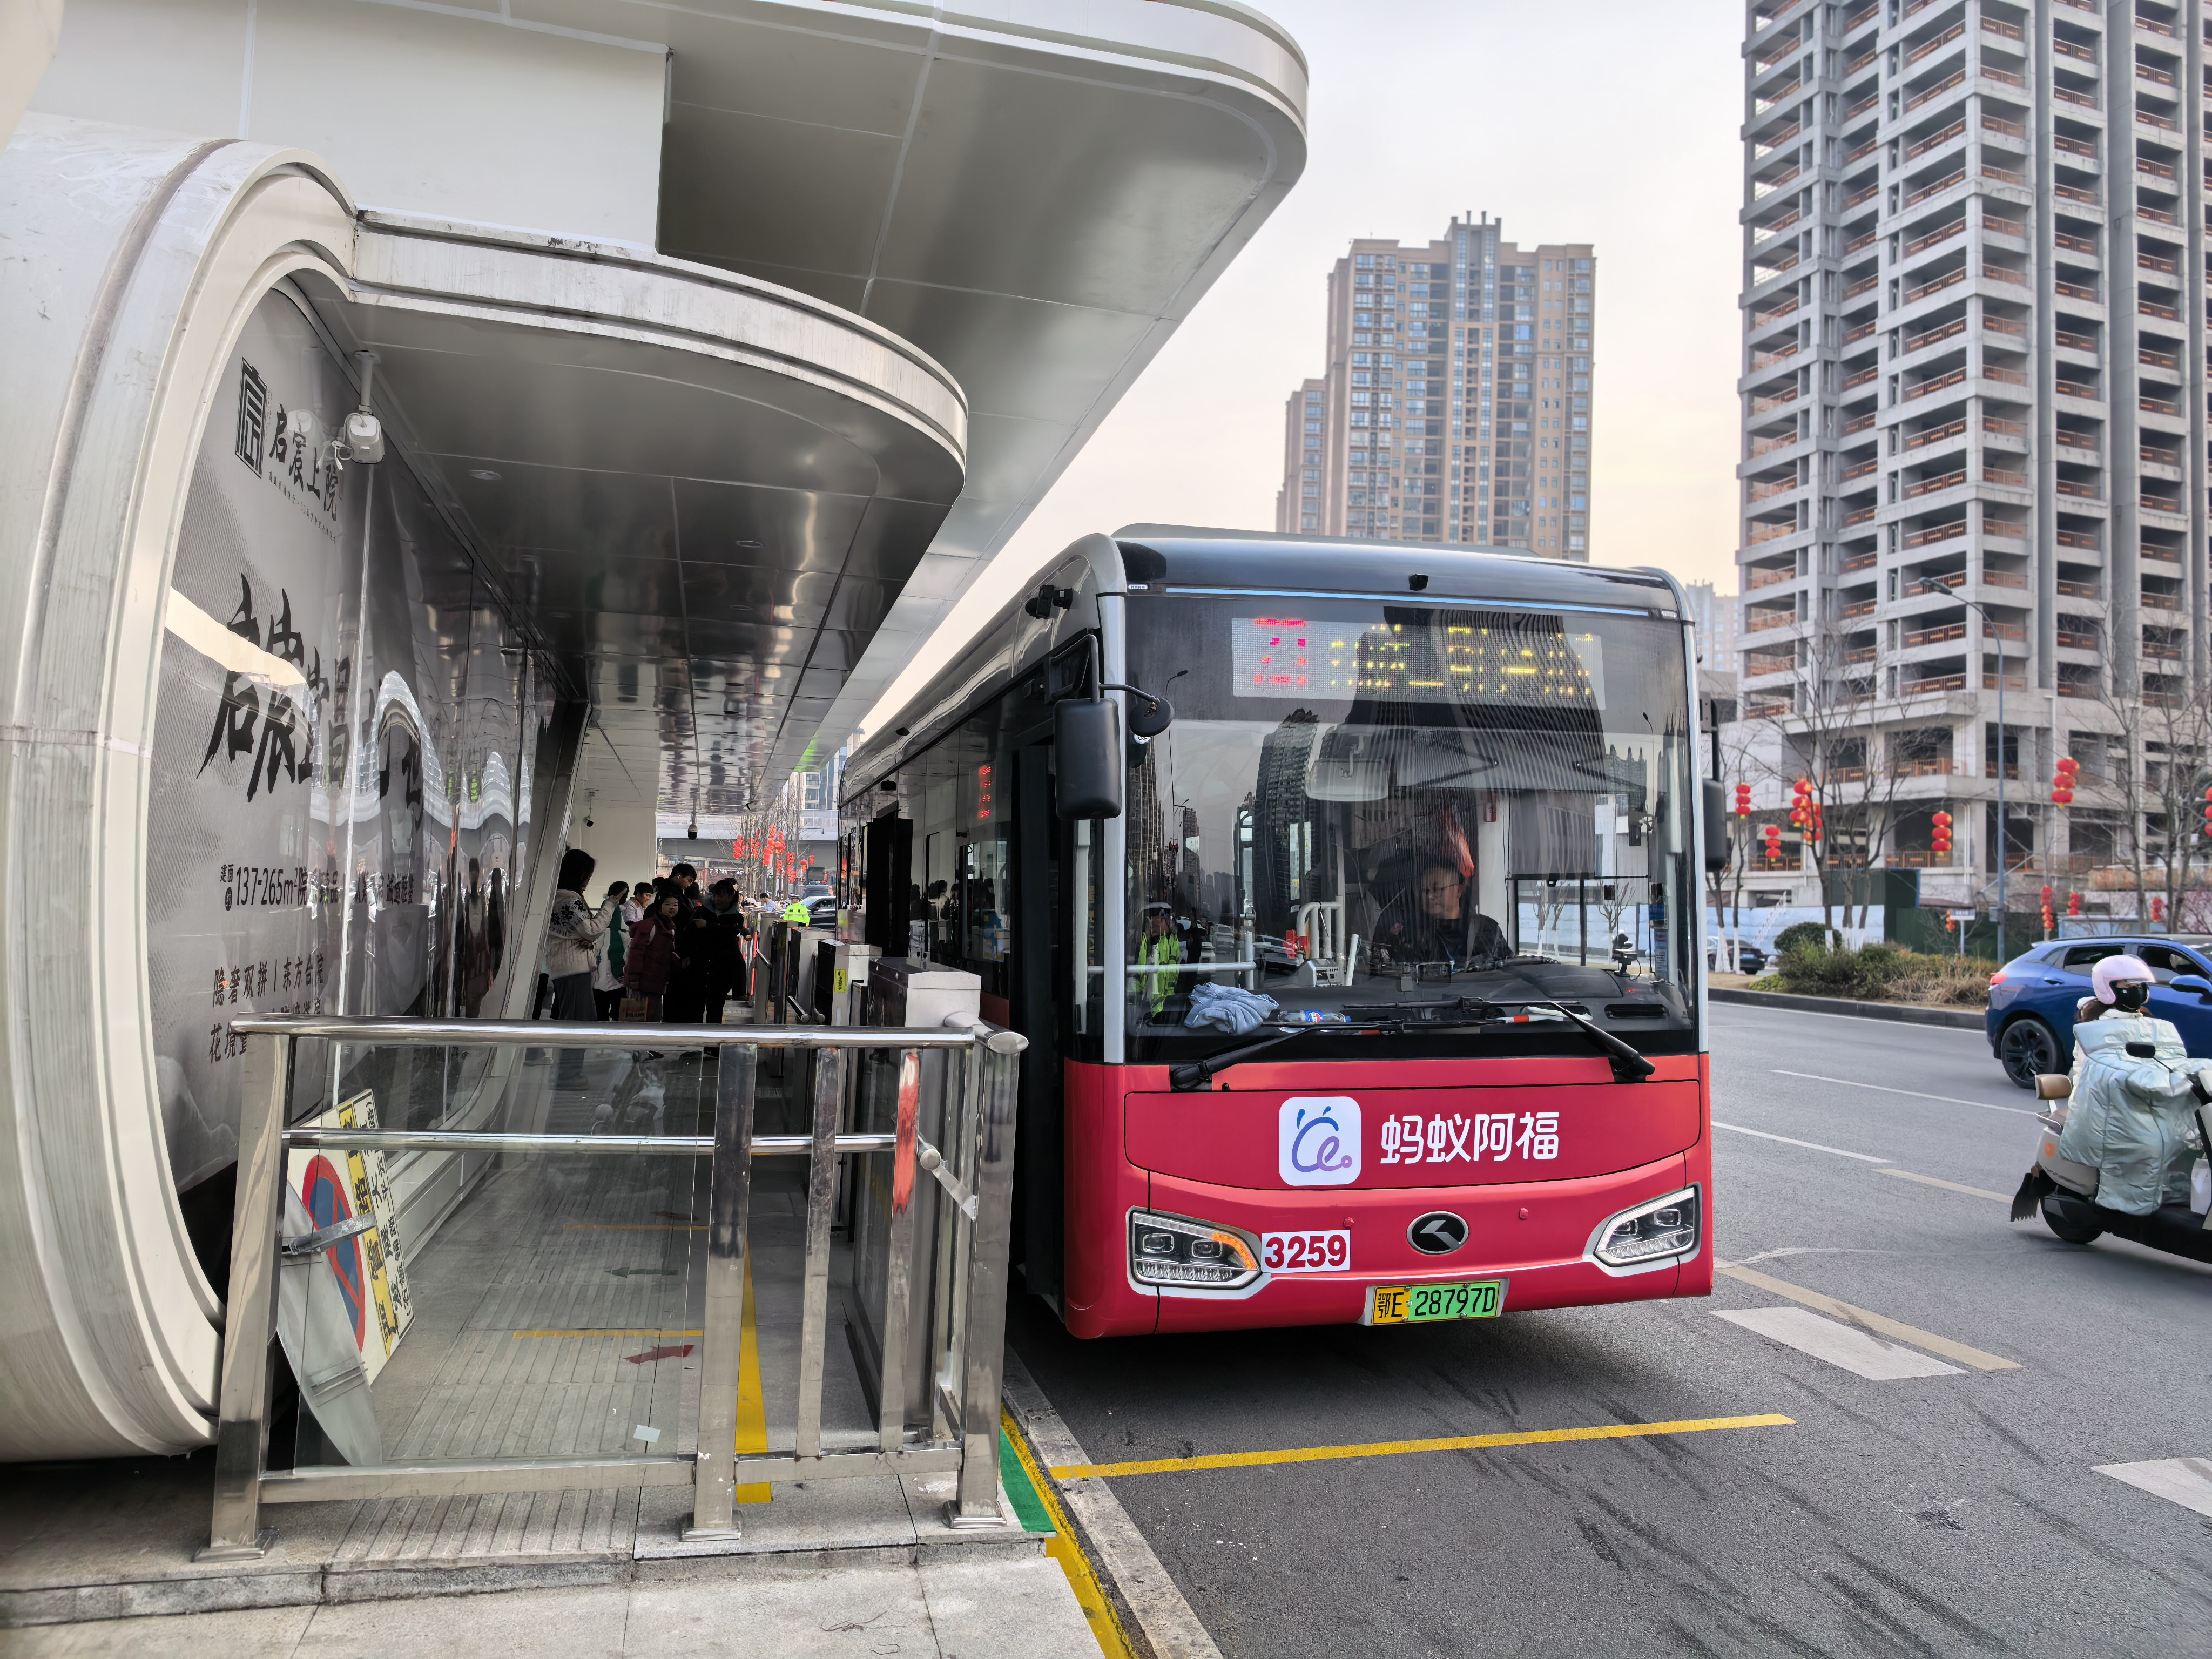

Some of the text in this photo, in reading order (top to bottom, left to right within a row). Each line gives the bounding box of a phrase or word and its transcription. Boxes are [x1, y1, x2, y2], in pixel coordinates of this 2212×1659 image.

[1380, 1111, 1560, 1165] 蚂蚁阿福
[1264, 1235, 1348, 1269] 3259
